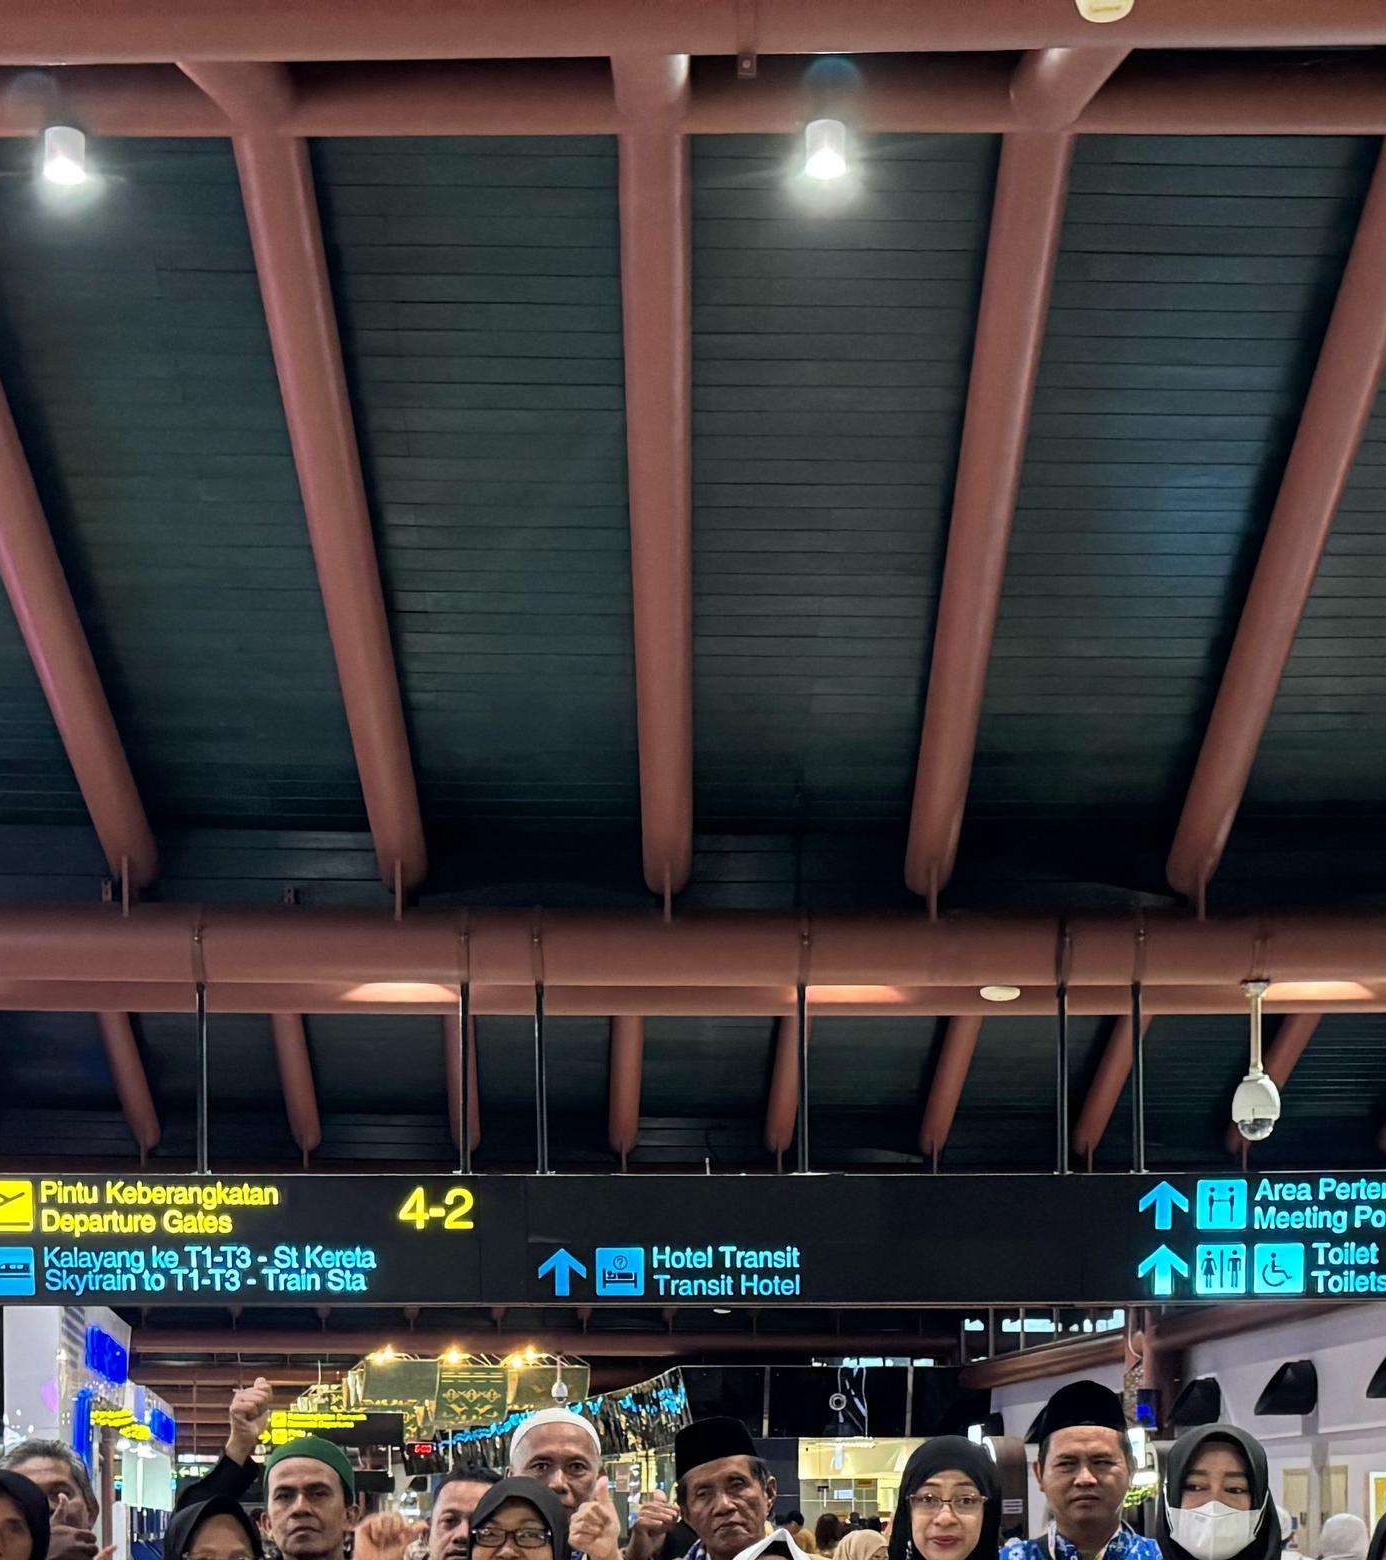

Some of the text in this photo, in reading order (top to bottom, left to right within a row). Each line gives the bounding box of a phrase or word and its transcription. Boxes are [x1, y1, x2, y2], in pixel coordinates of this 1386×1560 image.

[1254, 1178, 1312, 1201] Area
[40, 1181, 474, 1230] Pintu Keberangkatan 4-2
[41, 1210, 233, 1238] Departure Gates
[1254, 1206, 1349, 1234] Meeting
[43, 1246, 145, 1273] Kalayang
[151, 1246, 179, 1268] ke
[184, 1247, 251, 1268] T1-T3
[273, 1247, 300, 1268] St
[304, 1246, 377, 1268] Kereta
[652, 1246, 800, 1268] Hotel Transit
[1311, 1242, 1380, 1266] Toilet
[44, 1269, 137, 1294] Skytrain
[142, 1271, 166, 1290] to
[174, 1270, 241, 1290] T1-T3
[260, 1269, 323, 1291] Train
[329, 1269, 367, 1291] Sta
[653, 1275, 801, 1296] Transit Hotel
